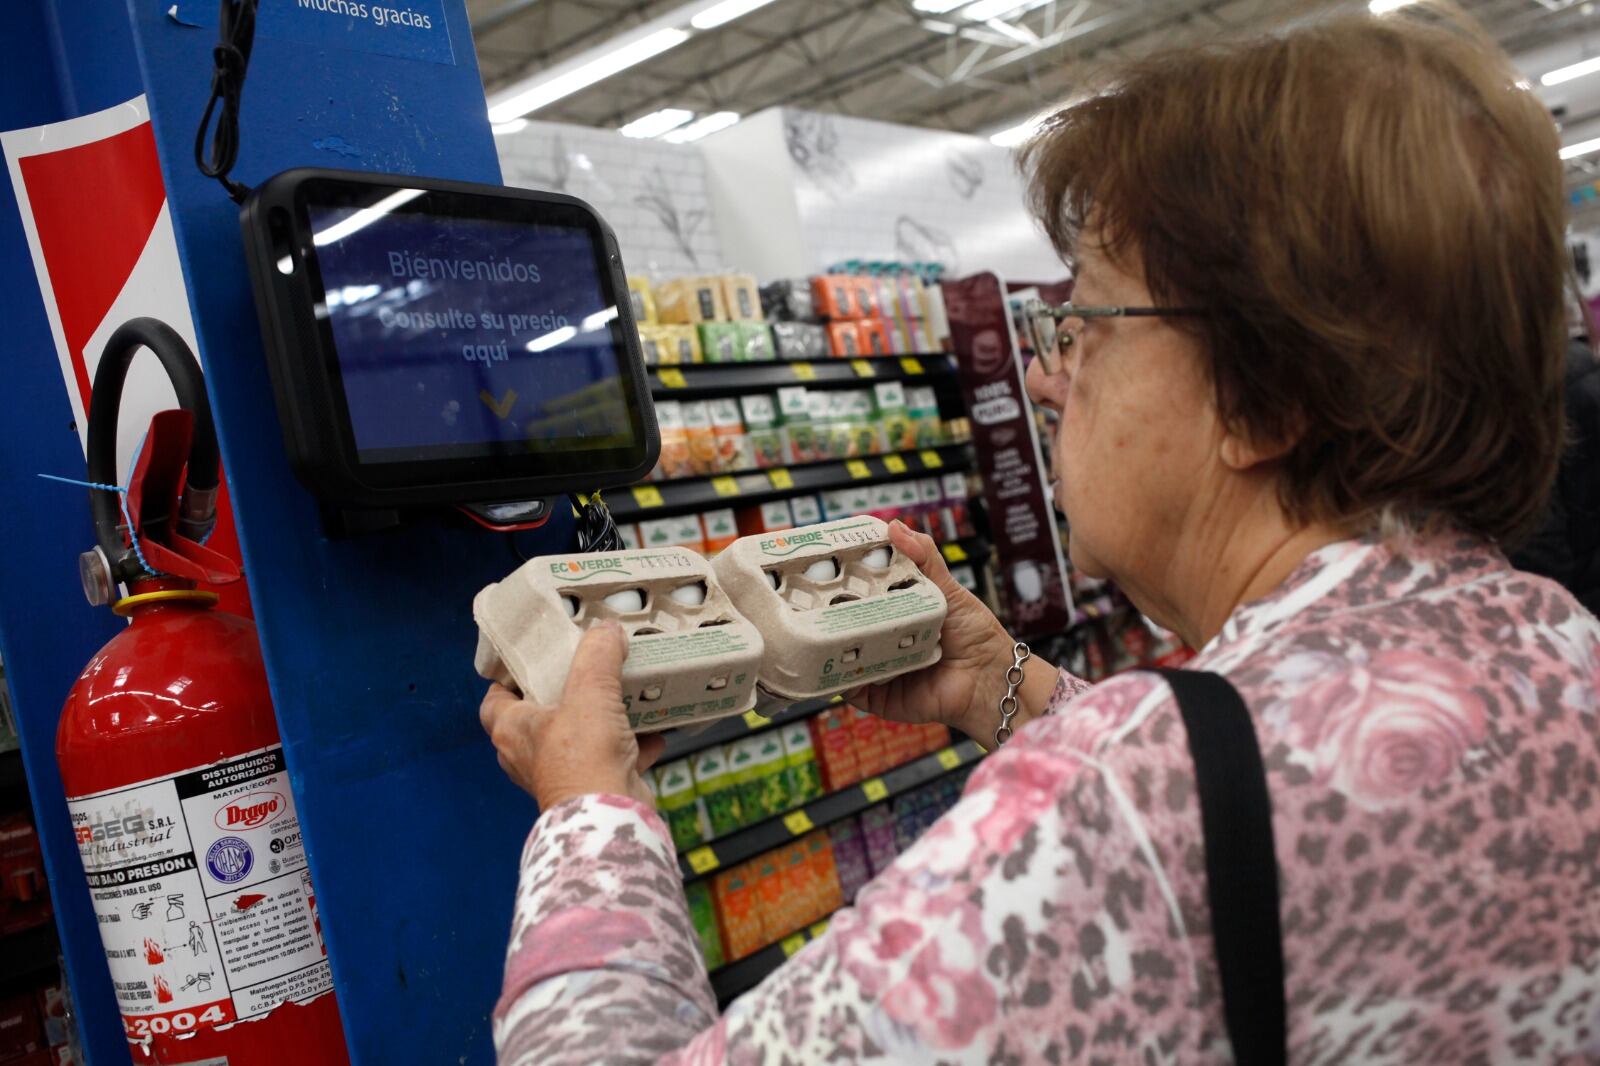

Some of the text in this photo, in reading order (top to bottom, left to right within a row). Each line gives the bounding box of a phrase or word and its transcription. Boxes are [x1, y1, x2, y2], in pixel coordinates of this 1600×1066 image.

[372, 6, 432, 29] gracias
[388, 251, 541, 284] Bienvenidos
[379, 307, 568, 335] Consulte su precio
[462, 340, 509, 368] aquí
[760, 531, 824, 550] ECOVERDE
[550, 558, 622, 573] ECOVERDE
[201, 754, 277, 781] DISTRIBUIDOR
[208, 763, 276, 788] AUTORIZADO
[213, 777, 278, 800] MATAFUEGOS
[226, 799, 278, 826] Drago
[96, 827, 175, 855] Industrial
[101, 871, 125, 885] BAJO
[127, 858, 186, 881] PRESION
[123, 888, 138, 897] PARA
[140, 886, 147, 894] EL
[148, 882, 162, 892] USO
[260, 905, 278, 915] donde
[243, 944, 281, 960] correctamente
[248, 959, 266, 967] Norma
[250, 981, 287, 996] Matafuegos
[287, 968, 319, 984] MEGASEG
[261, 988, 287, 1000] Registro
